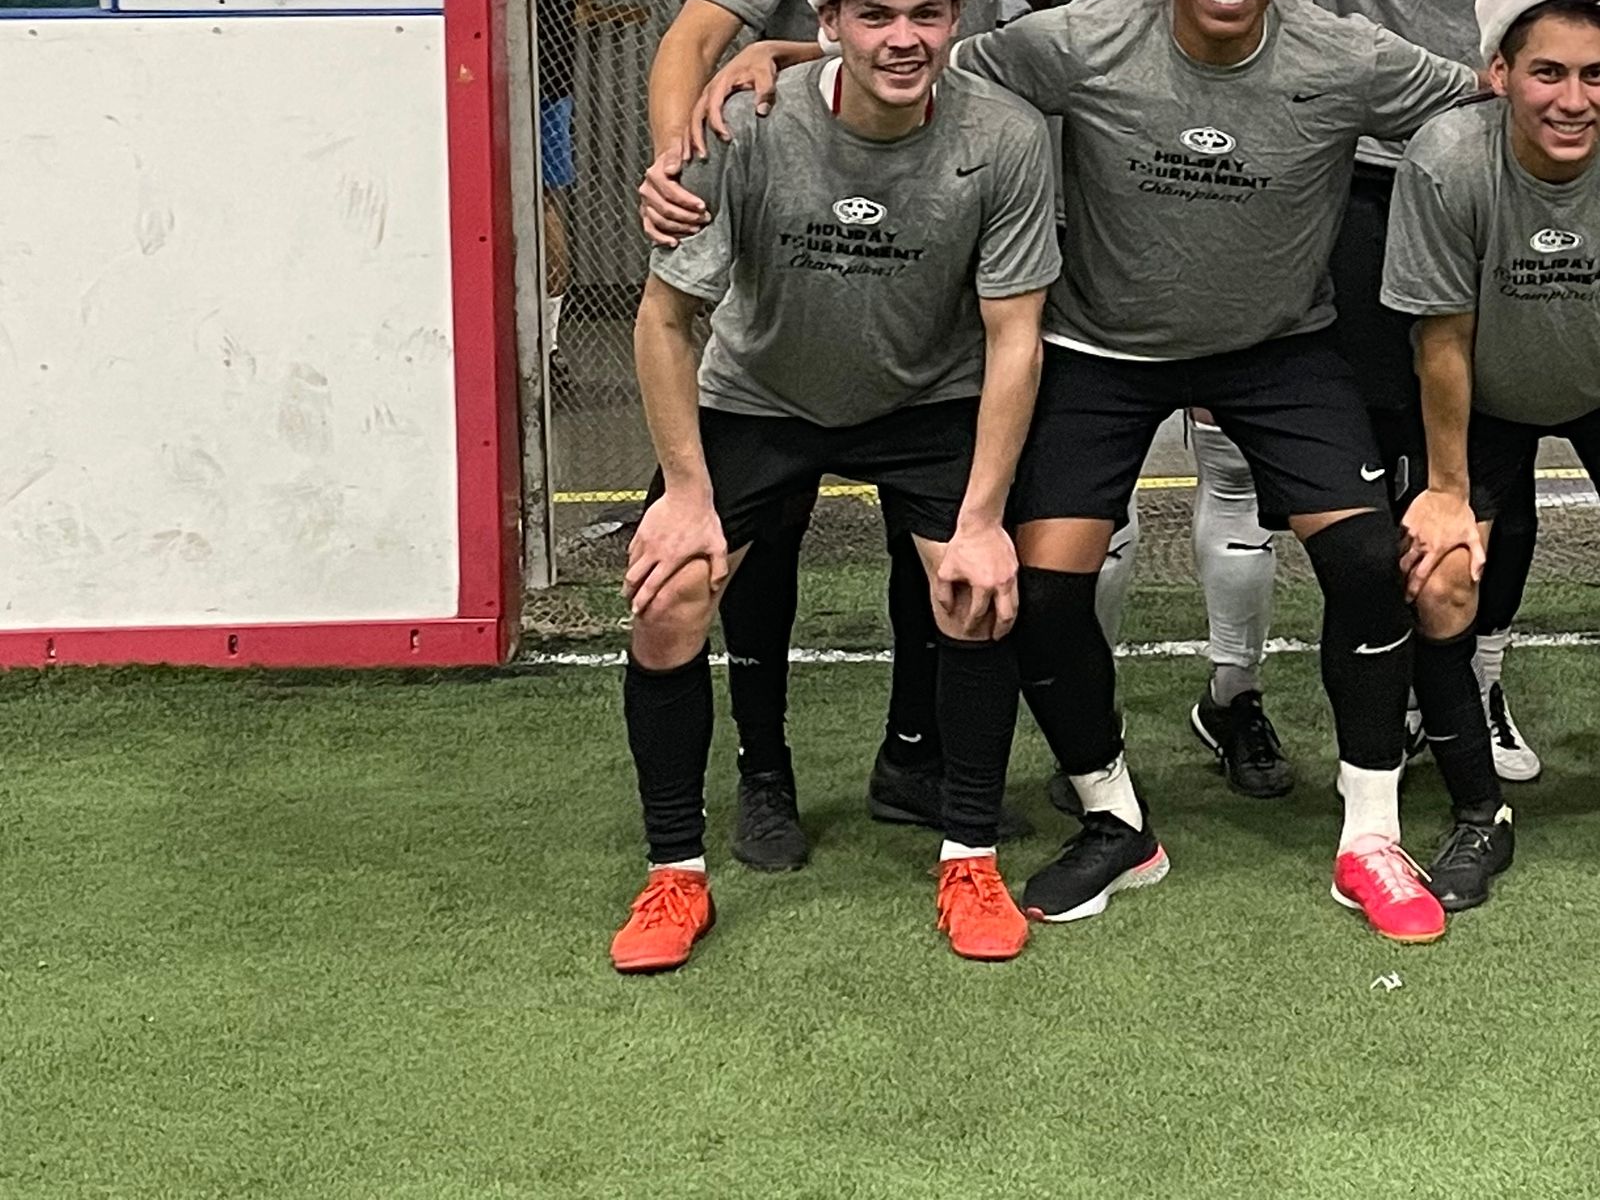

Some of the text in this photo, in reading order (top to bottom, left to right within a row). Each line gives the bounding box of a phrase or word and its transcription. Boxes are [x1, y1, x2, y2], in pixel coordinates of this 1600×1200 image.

[1155, 151, 1245, 172] HOLIDAY
[807, 222, 898, 243] HOLIDAY
[1511, 258, 1596, 271] HOLIDAY
